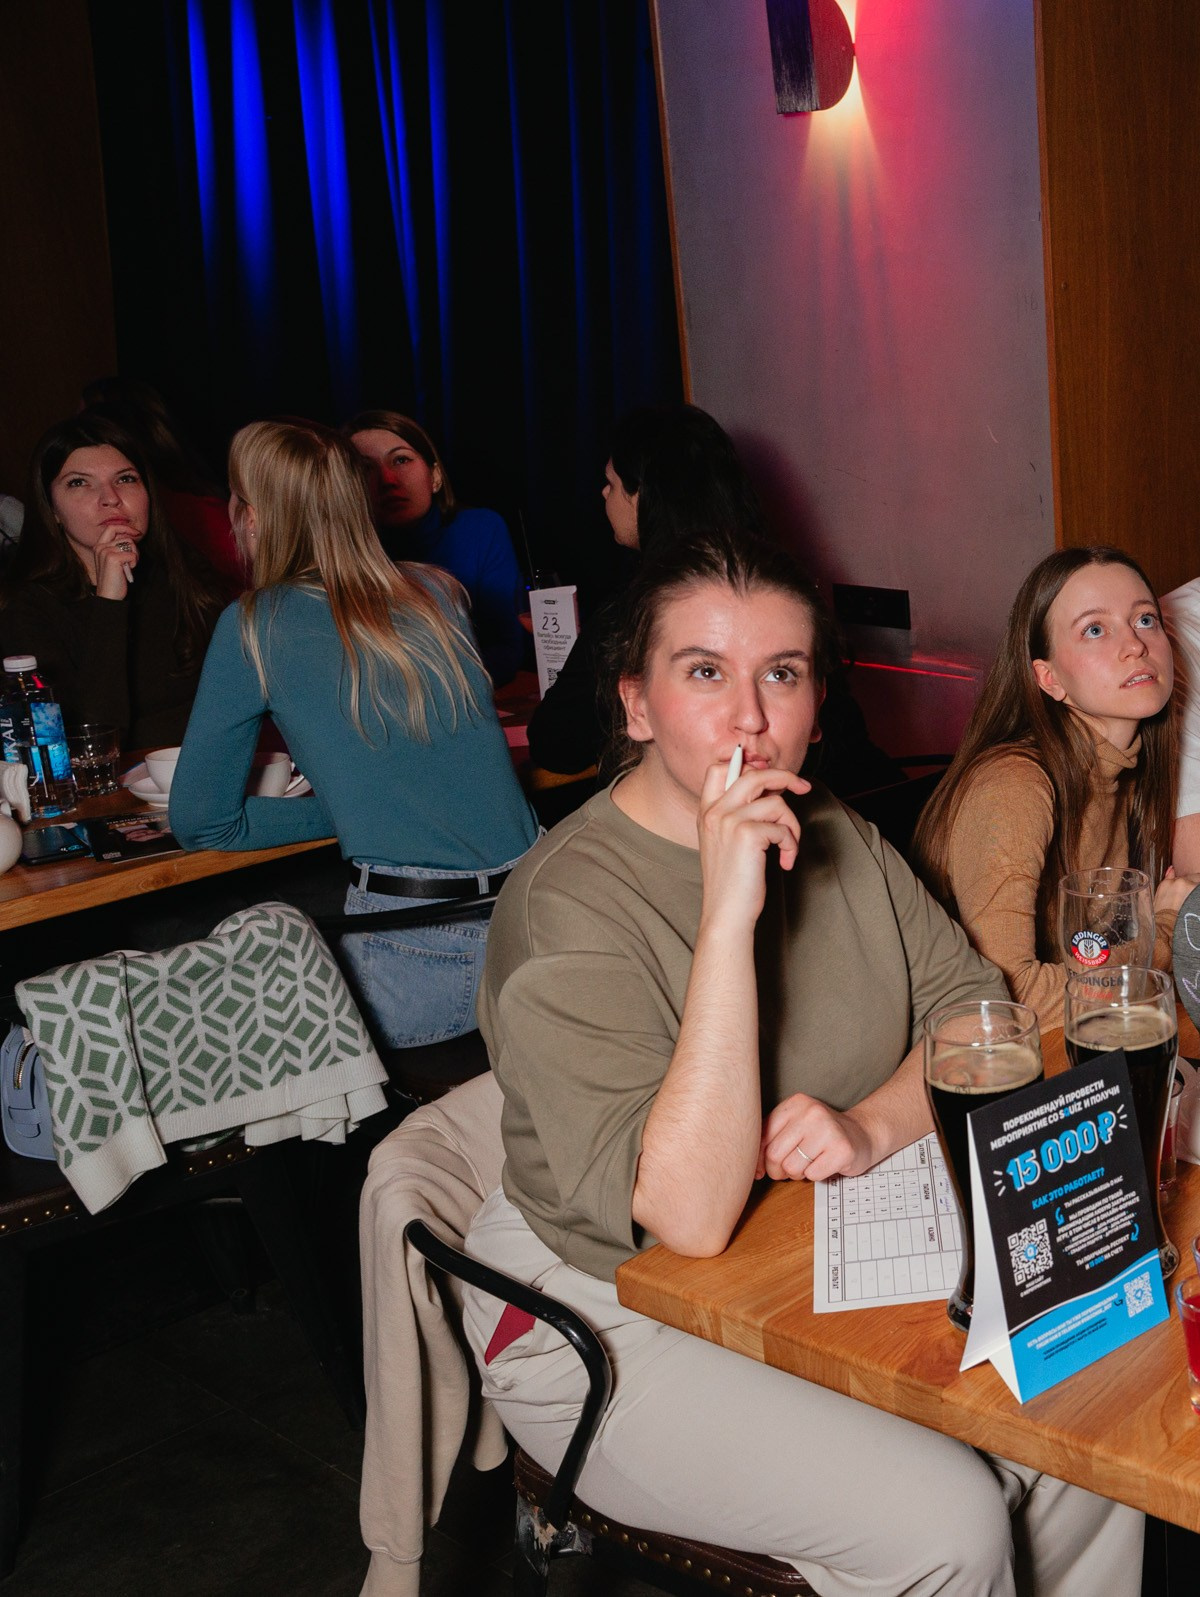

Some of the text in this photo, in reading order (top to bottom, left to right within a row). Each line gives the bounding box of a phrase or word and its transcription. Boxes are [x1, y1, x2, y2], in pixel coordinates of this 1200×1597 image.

[542, 616, 560, 633] 23
[1071, 930, 1108, 949] ERDINGER
[990, 1117, 1047, 1149] МЕРОПРИЯТИЕ
[1048, 1112, 1058, 1124] СО
[1083, 1099, 1089, 1108] И
[1090, 1085, 1119, 1105] ПОЛУЧИ
[1003, 1079, 1103, 1131] ПОРЕКОМЕНДУЙ ПРОВЕСТИ
[1032, 1166, 1104, 1209] КАК ЭТО РАБОТАЕТ?
